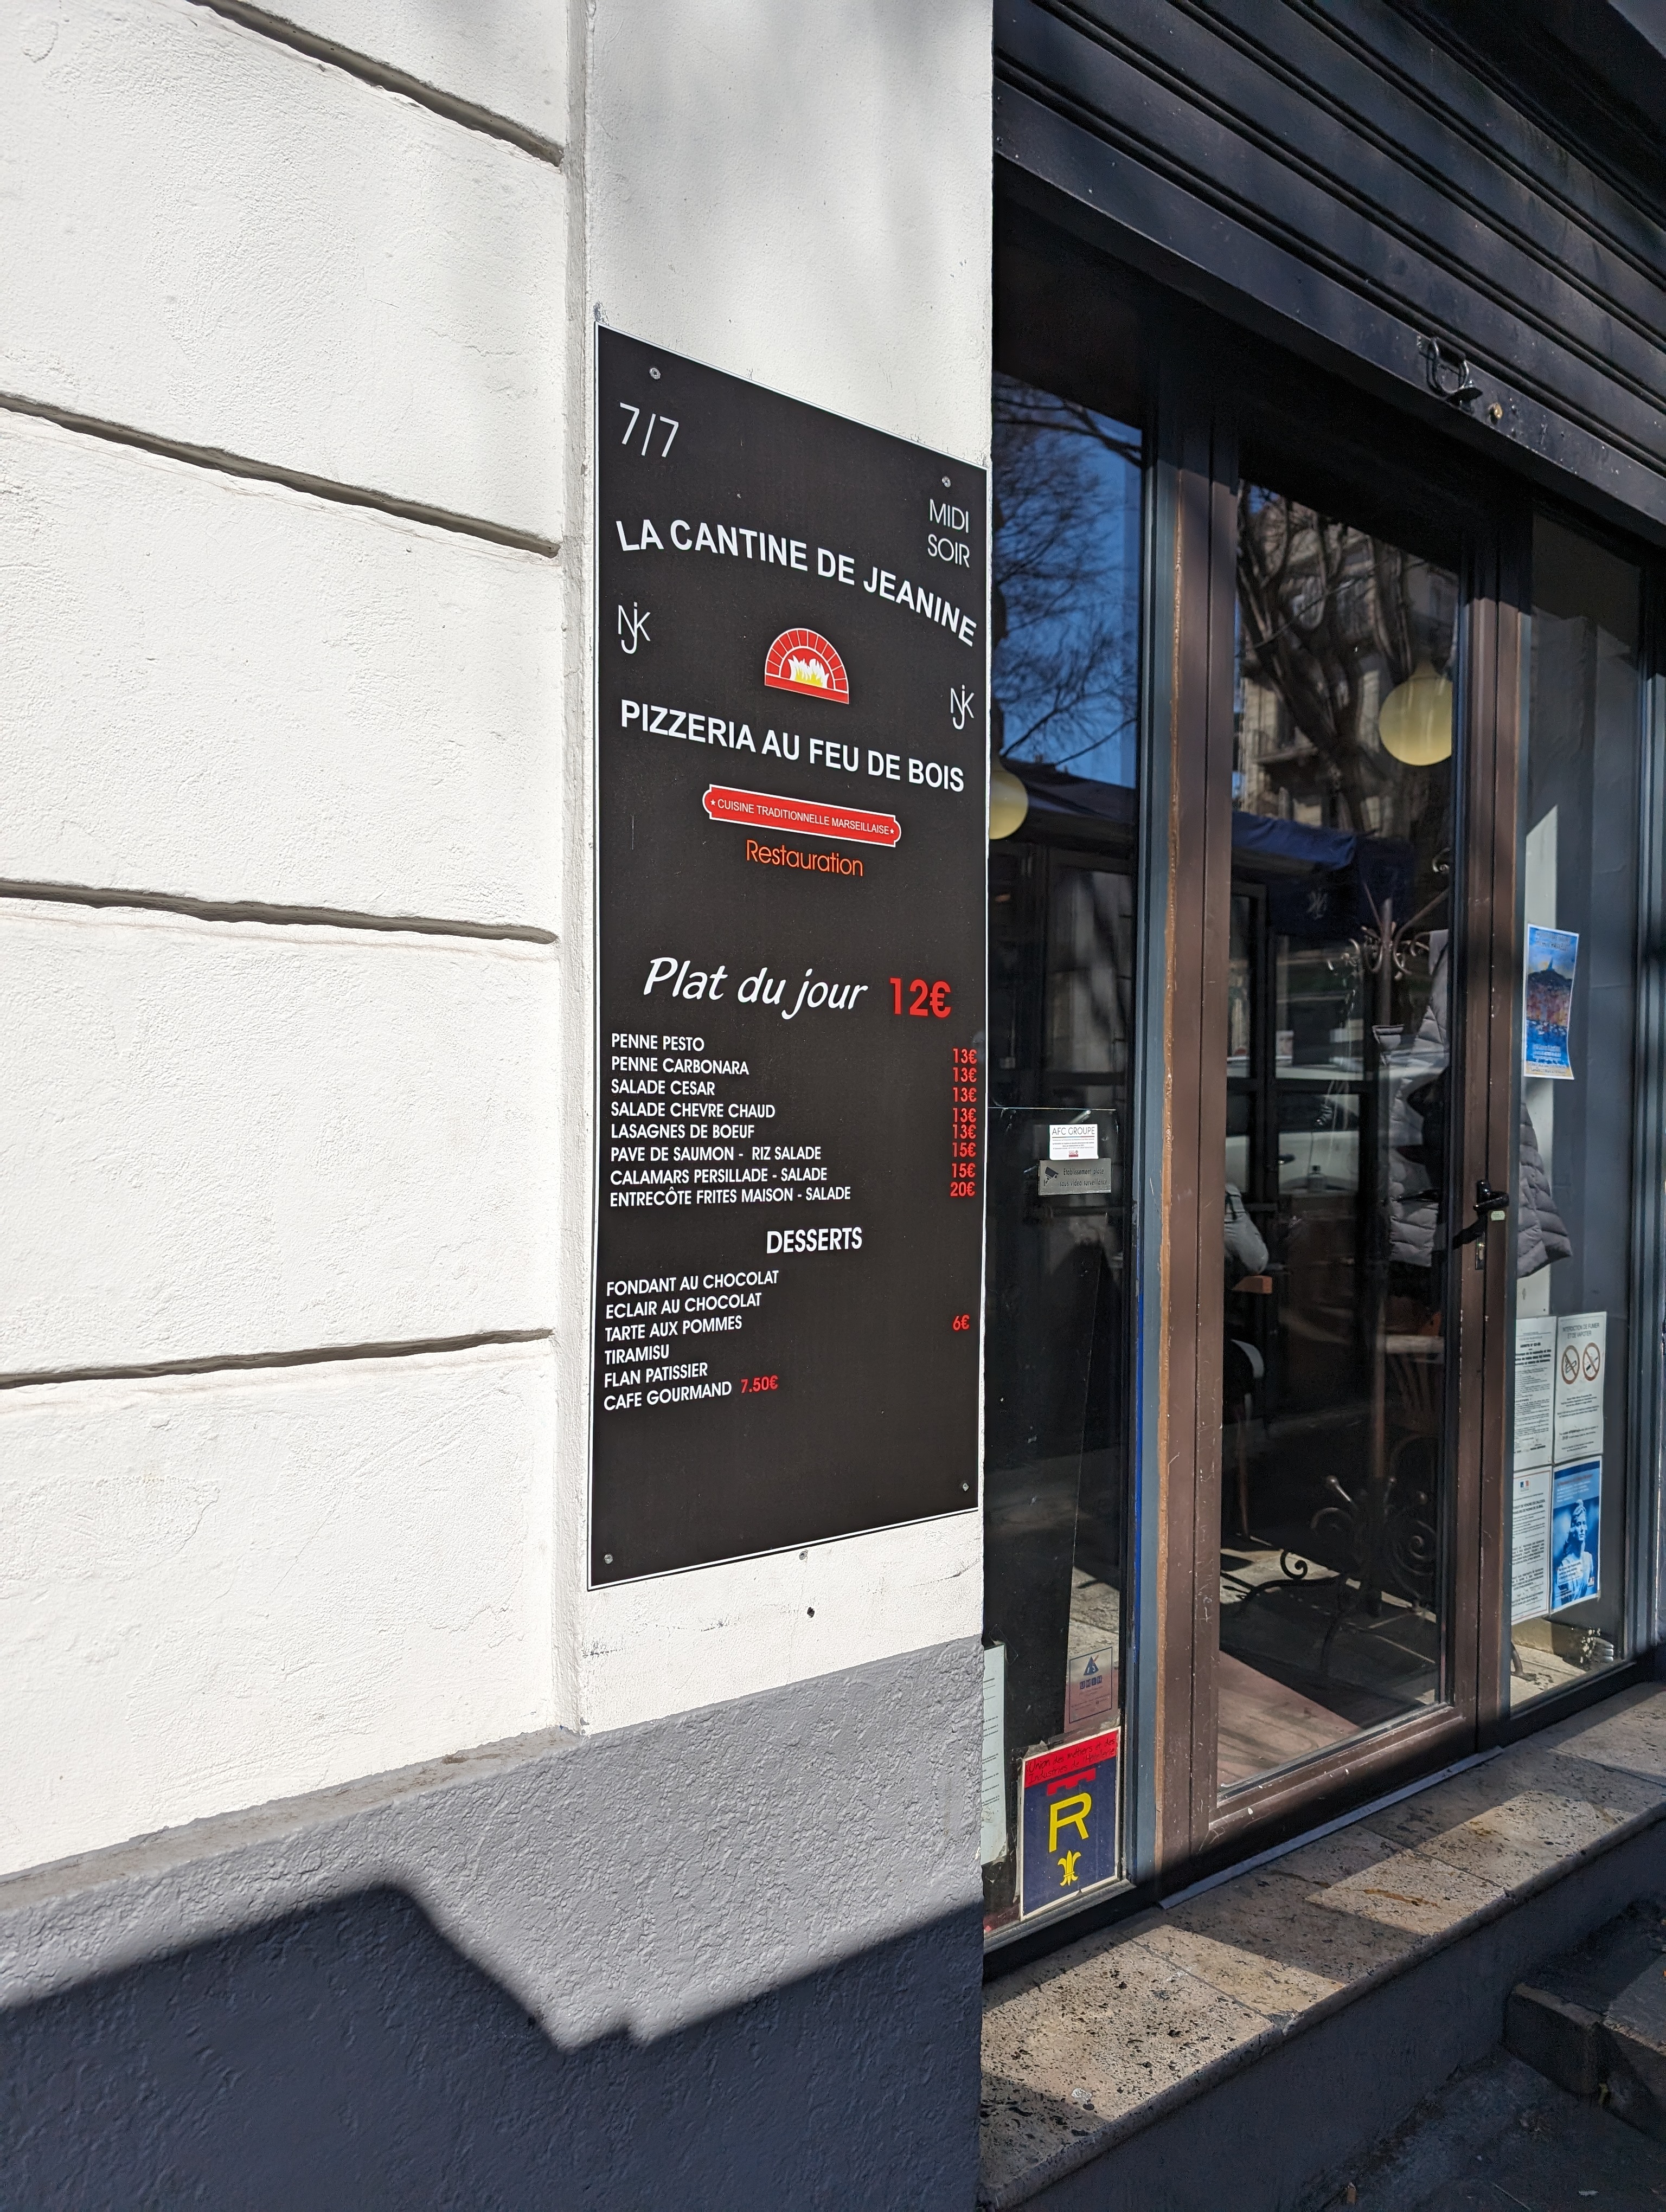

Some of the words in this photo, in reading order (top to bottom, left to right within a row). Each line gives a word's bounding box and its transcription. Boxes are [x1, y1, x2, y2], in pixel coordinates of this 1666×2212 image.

[620, 402, 679, 458] 7/7
[928, 499, 969, 533] MIDI
[927, 533, 970, 568] SOIR
[616, 519, 664, 551] LA
[670, 519, 808, 571] CANTINE
[817, 547, 855, 586] DE
[863, 567, 977, 647] JEANINE
[621, 699, 757, 753] PIZZERIA
[761, 729, 799, 760] AU
[810, 738, 858, 772] FEU
[868, 750, 900, 781] DE
[908, 758, 964, 792] BOIS
[717, 799, 754, 814] CUISINE
[756, 805, 830, 826] TRADITIONNELLE
[831, 817, 889, 835] MARSEILLAISE
[746, 839, 863, 877] Restauration
[643, 957, 728, 1000] Plat
[738, 967, 785, 1005] du
[781, 968, 869, 1020] jour
[890, 978, 952, 1018] 12€
[612, 1033, 658, 1050] PENNE
[663, 1036, 704, 1052] PESTO
[612, 1056, 658, 1072] PENNE
[662, 1058, 749, 1075] CARBONARA
[953, 1048, 977, 1064] 13€
[953, 1067, 977, 1083] 13€
[611, 1078, 665, 1095] SALADE
[670, 1080, 715, 1096] CESAR
[953, 1087, 977, 1102] 13€
[611, 1101, 665, 1117] SALADE
[670, 1102, 724, 1117] CHEVRE
[728, 1103, 776, 1118] CHAUD
[953, 1107, 977, 1124] 13€
[611, 1123, 685, 1139] LASAGNES
[690, 1124, 708, 1139] DE
[713, 1124, 755, 1139] BOEUF
[952, 1124, 977, 1139] 13€
[1052, 1127, 1066, 1135] AFC
[1068, 1127, 1095, 1135] GROUPE
[611, 1147, 645, 1162] PAVE
[650, 1147, 669, 1161] DE
[673, 1146, 734, 1161] SAUMON
[752, 1146, 771, 1160] RIZ
[774, 1146, 821, 1160] SALADE
[952, 1142, 976, 1158] 15€
[610, 1169, 689, 1186] CALAMARS
[694, 1168, 768, 1184] PERSILLADE
[780, 1167, 828, 1182] SALADE
[952, 1162, 976, 1178] 15€
[950, 1181, 975, 1197] 20€
[1083, 1178, 1107, 1186] surveillance
[610, 1186, 692, 1207] ENTRECÔTE
[696, 1188, 737, 1204] FRITES
[741, 1187, 793, 1203] MAISON
[805, 1186, 851, 1201] SALADE
[766, 1226, 862, 1254] DESSERTS
[606, 1277, 677, 1297] FONDANT
[679, 1275, 699, 1291] AU
[703, 1270, 779, 1289] CHOCOLAT
[606, 1301, 657, 1320] ECLAIR
[660, 1298, 680, 1315] AU
[684, 1292, 762, 1312] CHOCOLAT
[605, 1323, 645, 1342] TARTE
[649, 1321, 678, 1338] AUX
[682, 1315, 742, 1335] POMMES
[952, 1314, 970, 1331] 6€
[604, 1343, 669, 1365] TIRAMISU
[604, 1369, 641, 1388] FLAN
[645, 1362, 708, 1383] PATISSIER
[604, 1391, 642, 1411] CAFE
[646, 1381, 732, 1405] GOURMAND
[741, 1375, 778, 1393] 7.50€
[1029, 1759, 1050, 1773] Union
[1052, 1755, 1065, 1765] des
[1095, 1742, 1102, 1751] et
[1104, 1738, 1116, 1746] des
[1071, 1760, 1080, 1769] de
[1049, 1792, 1092, 1853] R
